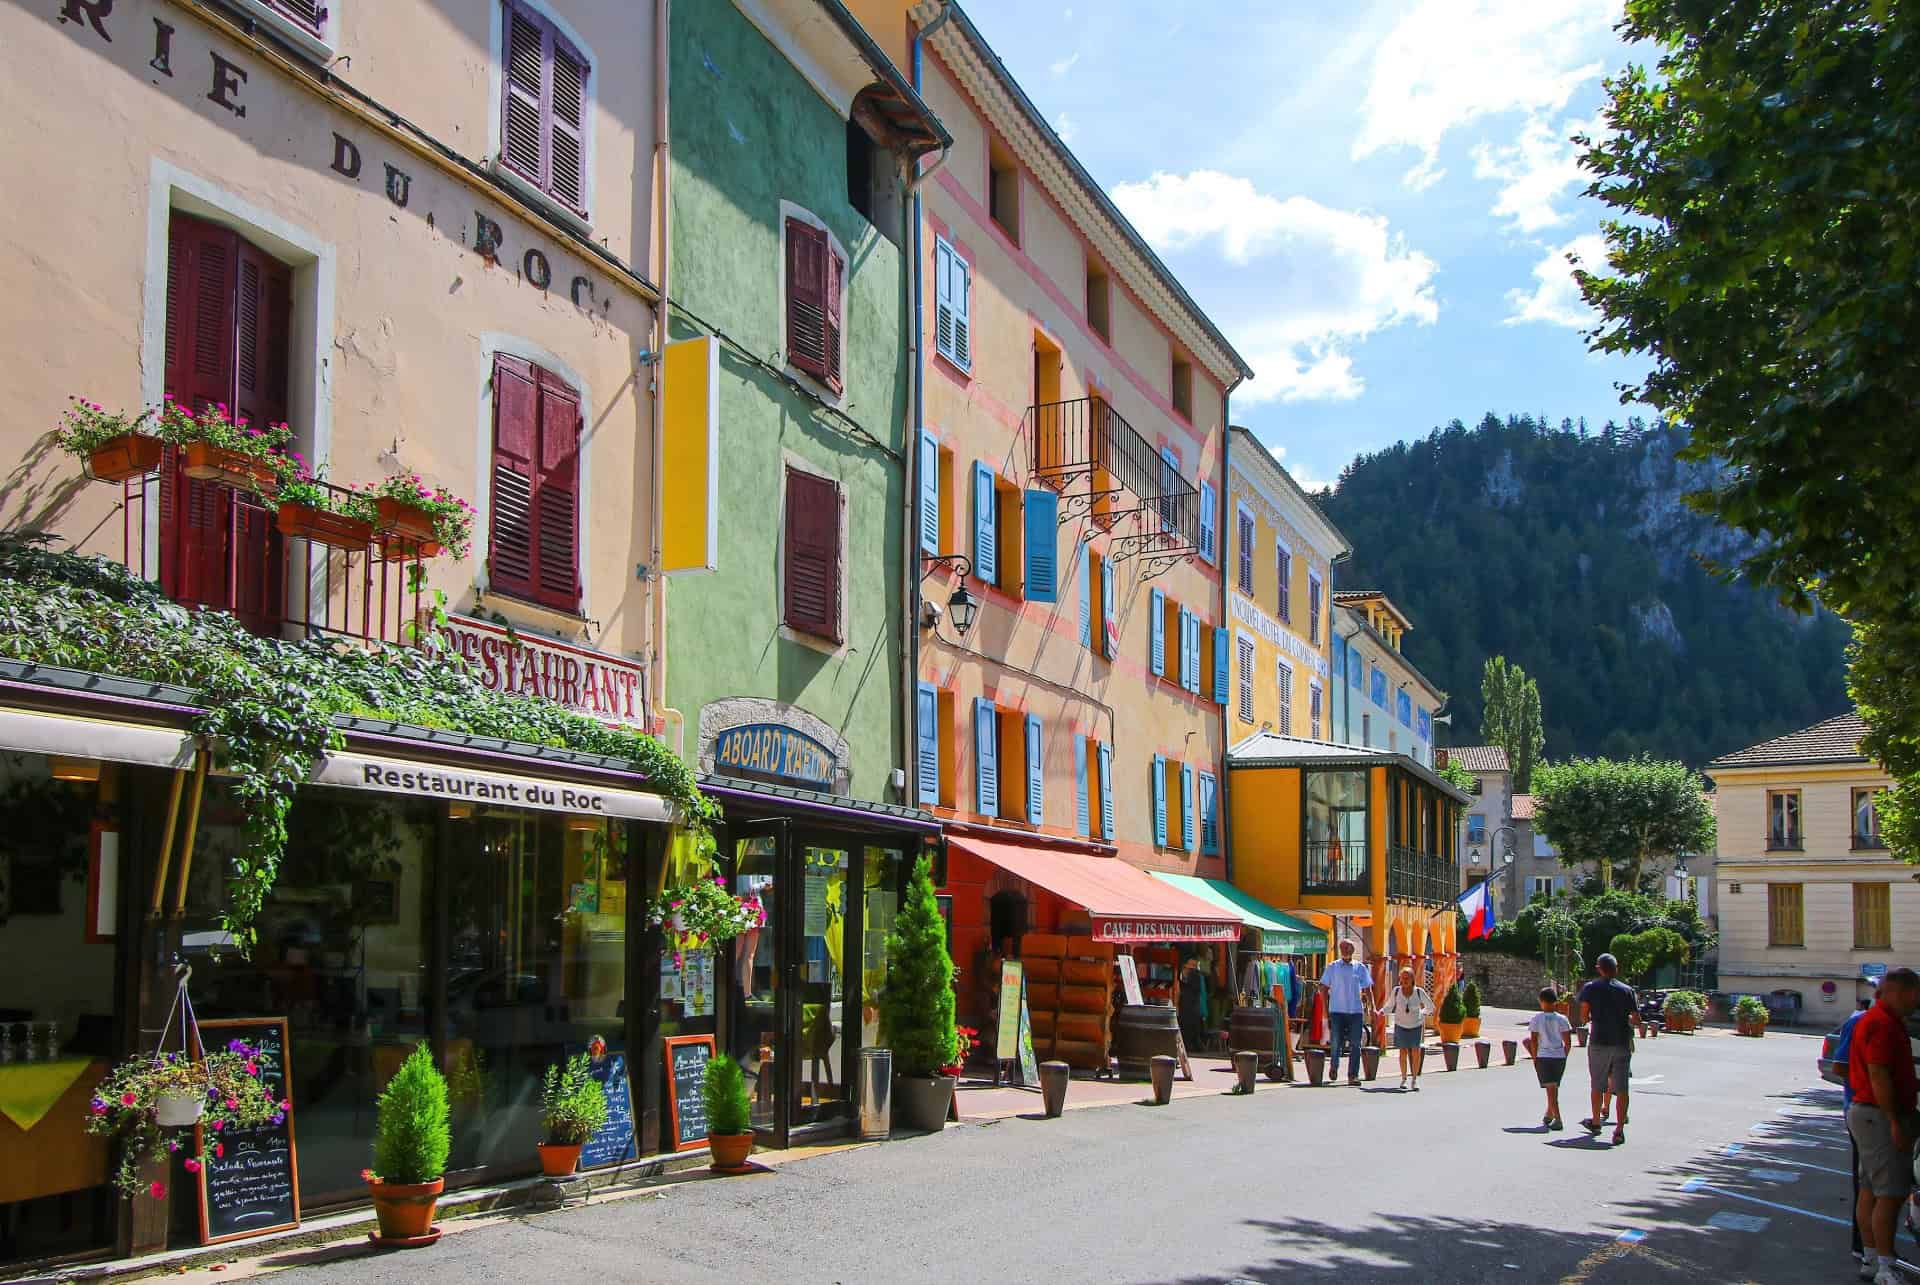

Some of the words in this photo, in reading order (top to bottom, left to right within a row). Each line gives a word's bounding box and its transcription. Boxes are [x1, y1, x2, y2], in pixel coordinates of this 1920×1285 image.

[331, 131, 411, 208] DU
[473, 210, 595, 309] ROC
[720, 729, 782, 772] ABOARD
[363, 763, 518, 802] Restaurant
[526, 785, 555, 806] du
[562, 789, 604, 811] Roc
[1103, 922, 1131, 938] CAVE
[1136, 922, 1157, 938] DES
[1160, 923, 1180, 938] VINS
[1184, 924, 1196, 937] DU
